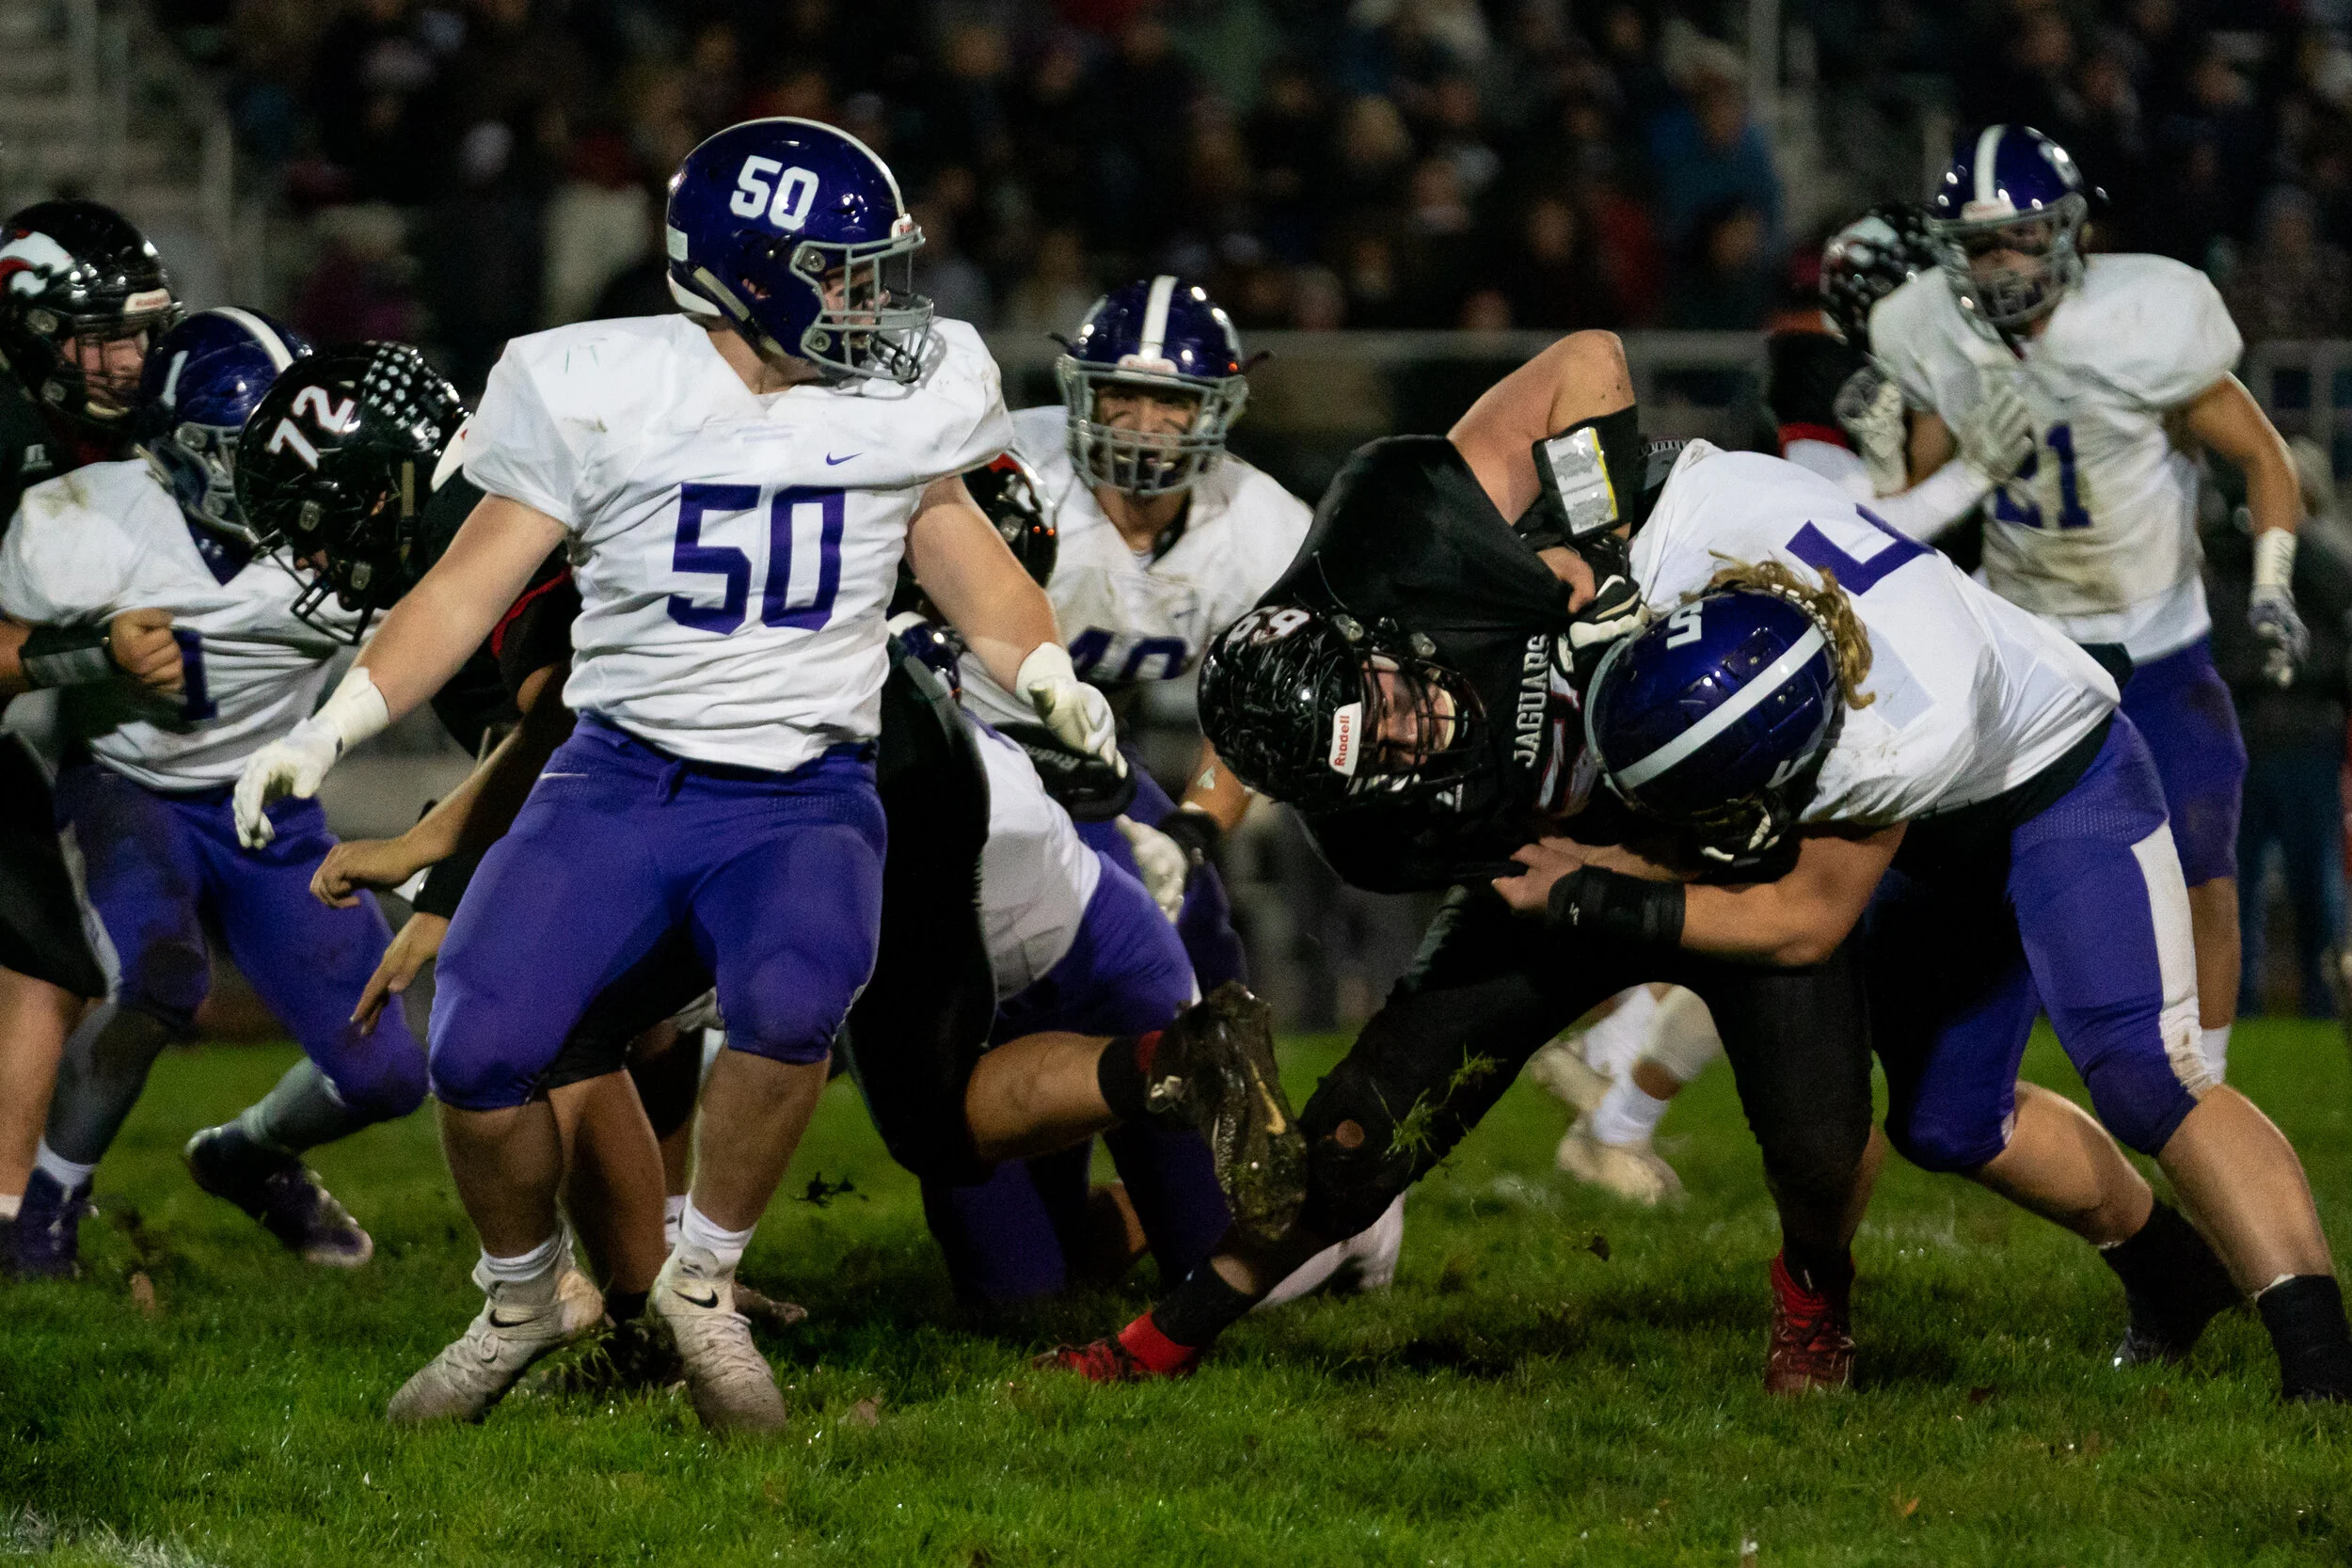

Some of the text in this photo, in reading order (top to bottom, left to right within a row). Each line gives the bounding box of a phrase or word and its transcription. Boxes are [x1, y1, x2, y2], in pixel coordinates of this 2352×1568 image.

[729, 154, 819, 231] 50
[267, 385, 357, 471] 72
[666, 481, 846, 636] 50
[1333, 715, 1350, 767] Riddell
[1513, 633, 1551, 768] JAGUARS
